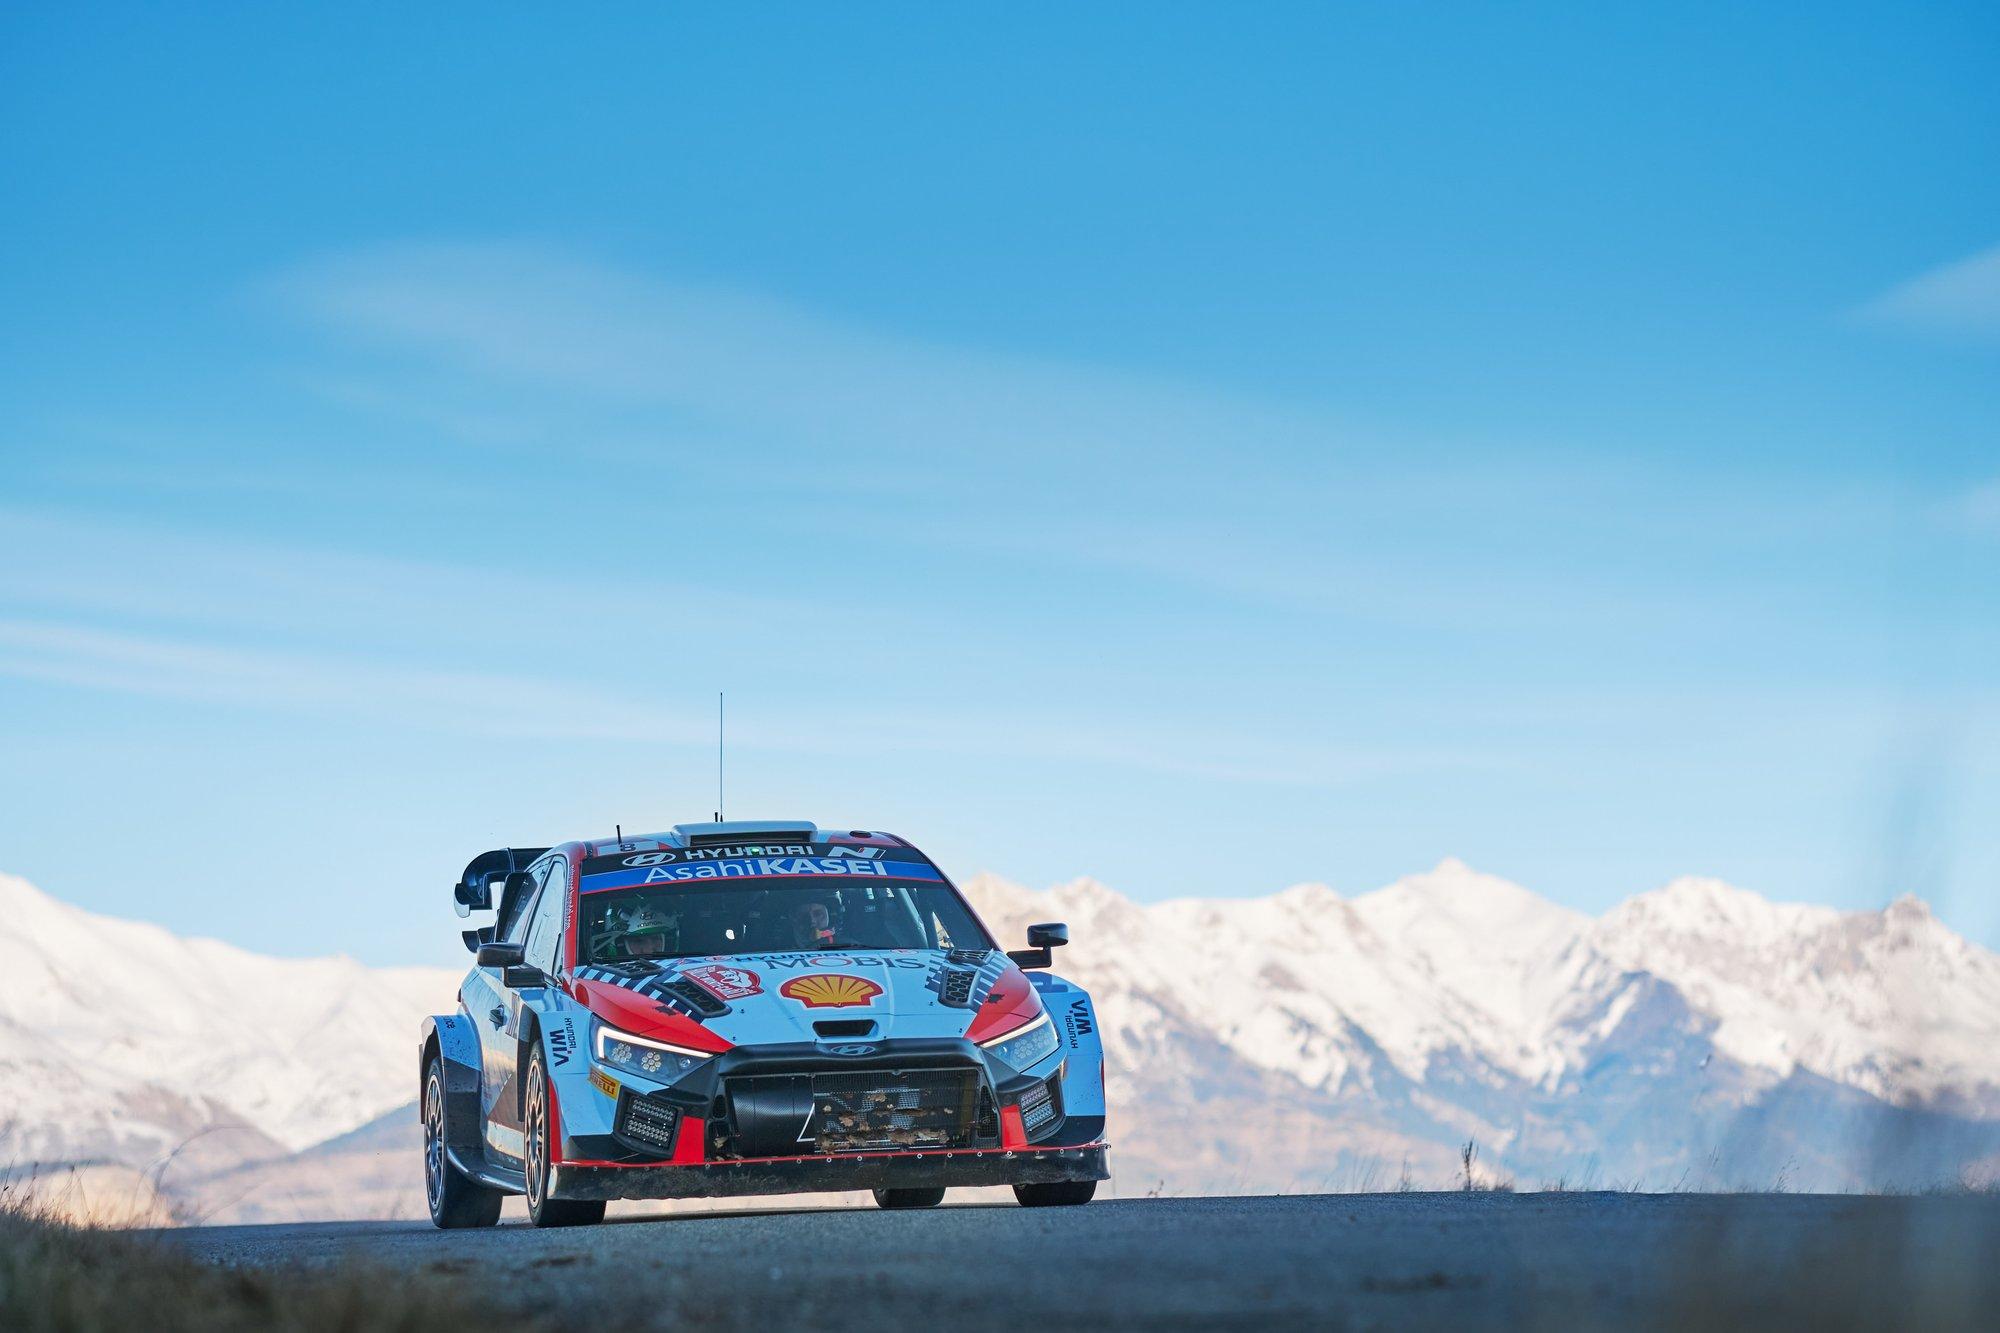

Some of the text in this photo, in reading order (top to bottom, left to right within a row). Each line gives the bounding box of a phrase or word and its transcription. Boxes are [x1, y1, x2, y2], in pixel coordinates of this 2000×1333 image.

[684, 845, 814, 861] HYUNDAI
[644, 859, 888, 884] AsahiKASEI
[766, 956, 926, 970] MOBIS
[564, 1017, 577, 1049] HYUNDAI
[1065, 1015, 1079, 1049] HYUNDAI
